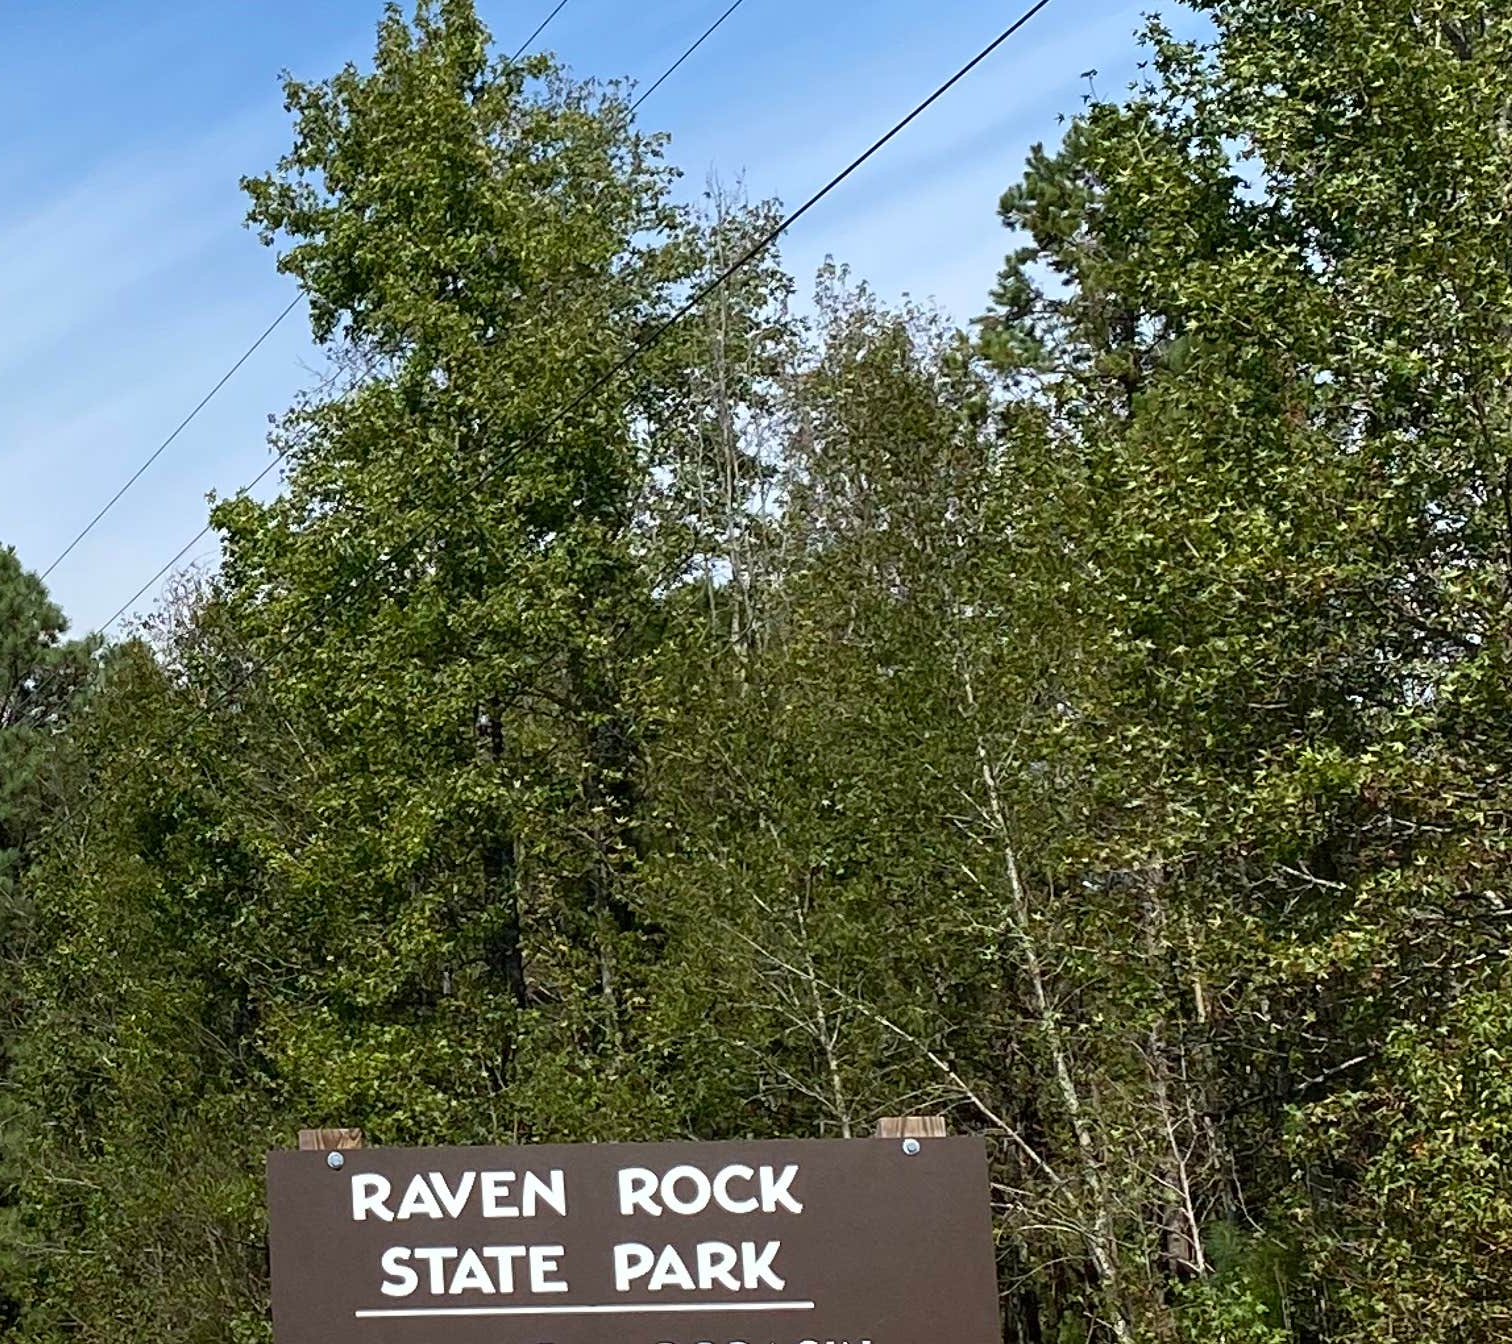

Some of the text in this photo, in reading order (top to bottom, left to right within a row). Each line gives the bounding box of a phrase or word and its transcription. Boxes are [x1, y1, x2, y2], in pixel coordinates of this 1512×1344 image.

[352, 1164, 803, 1221] RAVEN ROCK
[381, 1241, 785, 1296] STATE PARK
